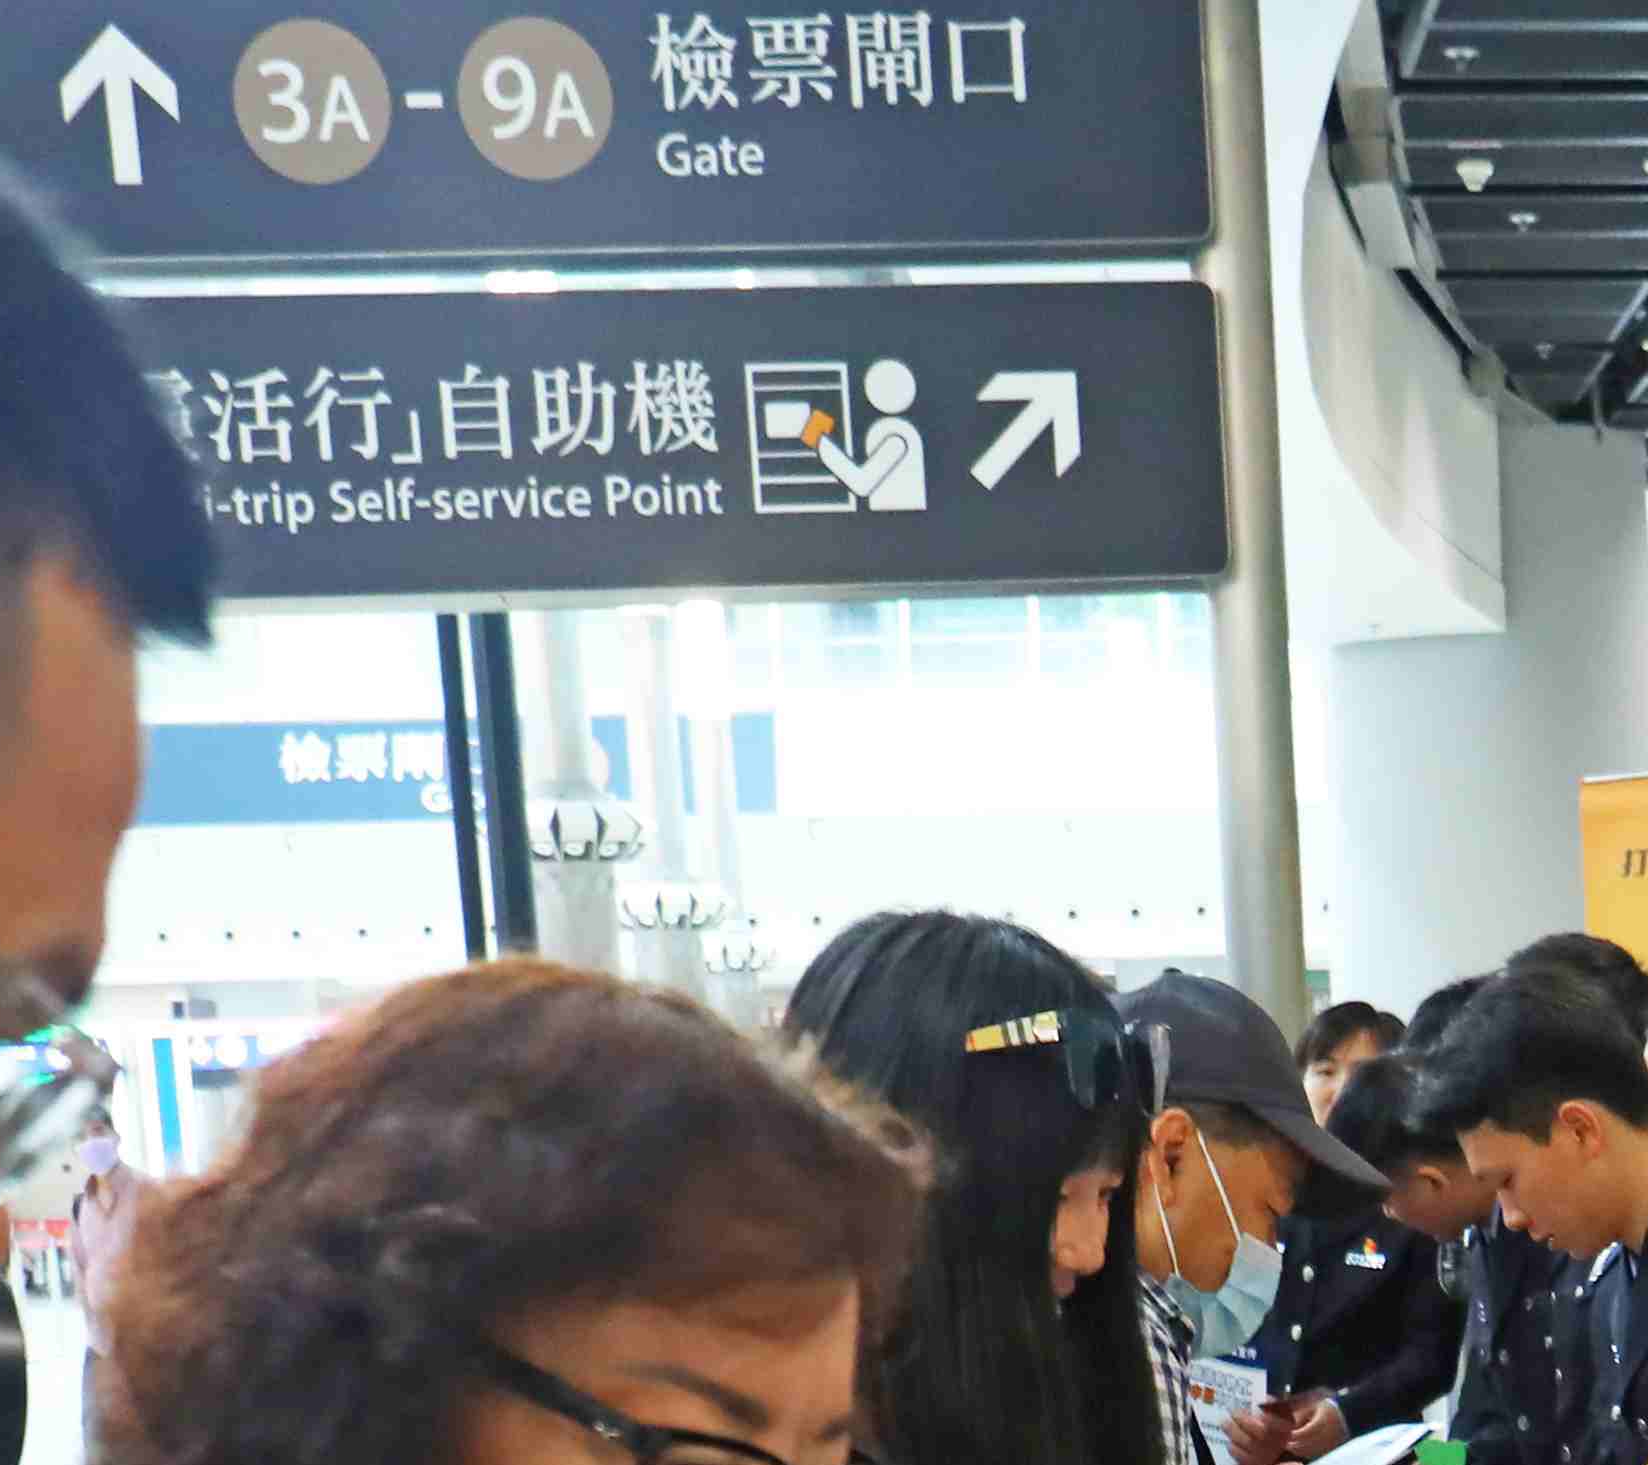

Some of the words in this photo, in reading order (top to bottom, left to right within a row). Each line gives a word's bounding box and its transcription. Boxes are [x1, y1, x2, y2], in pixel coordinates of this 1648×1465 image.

[648, 12, 1030, 111] 檢票閘口
[259, 58, 371, 145] 3A
[481, 54, 596, 142] 9A
[655, 132, 765, 178] Gate
[328, 474, 591, 523] Self-service
[604, 472, 724, 518] Point
